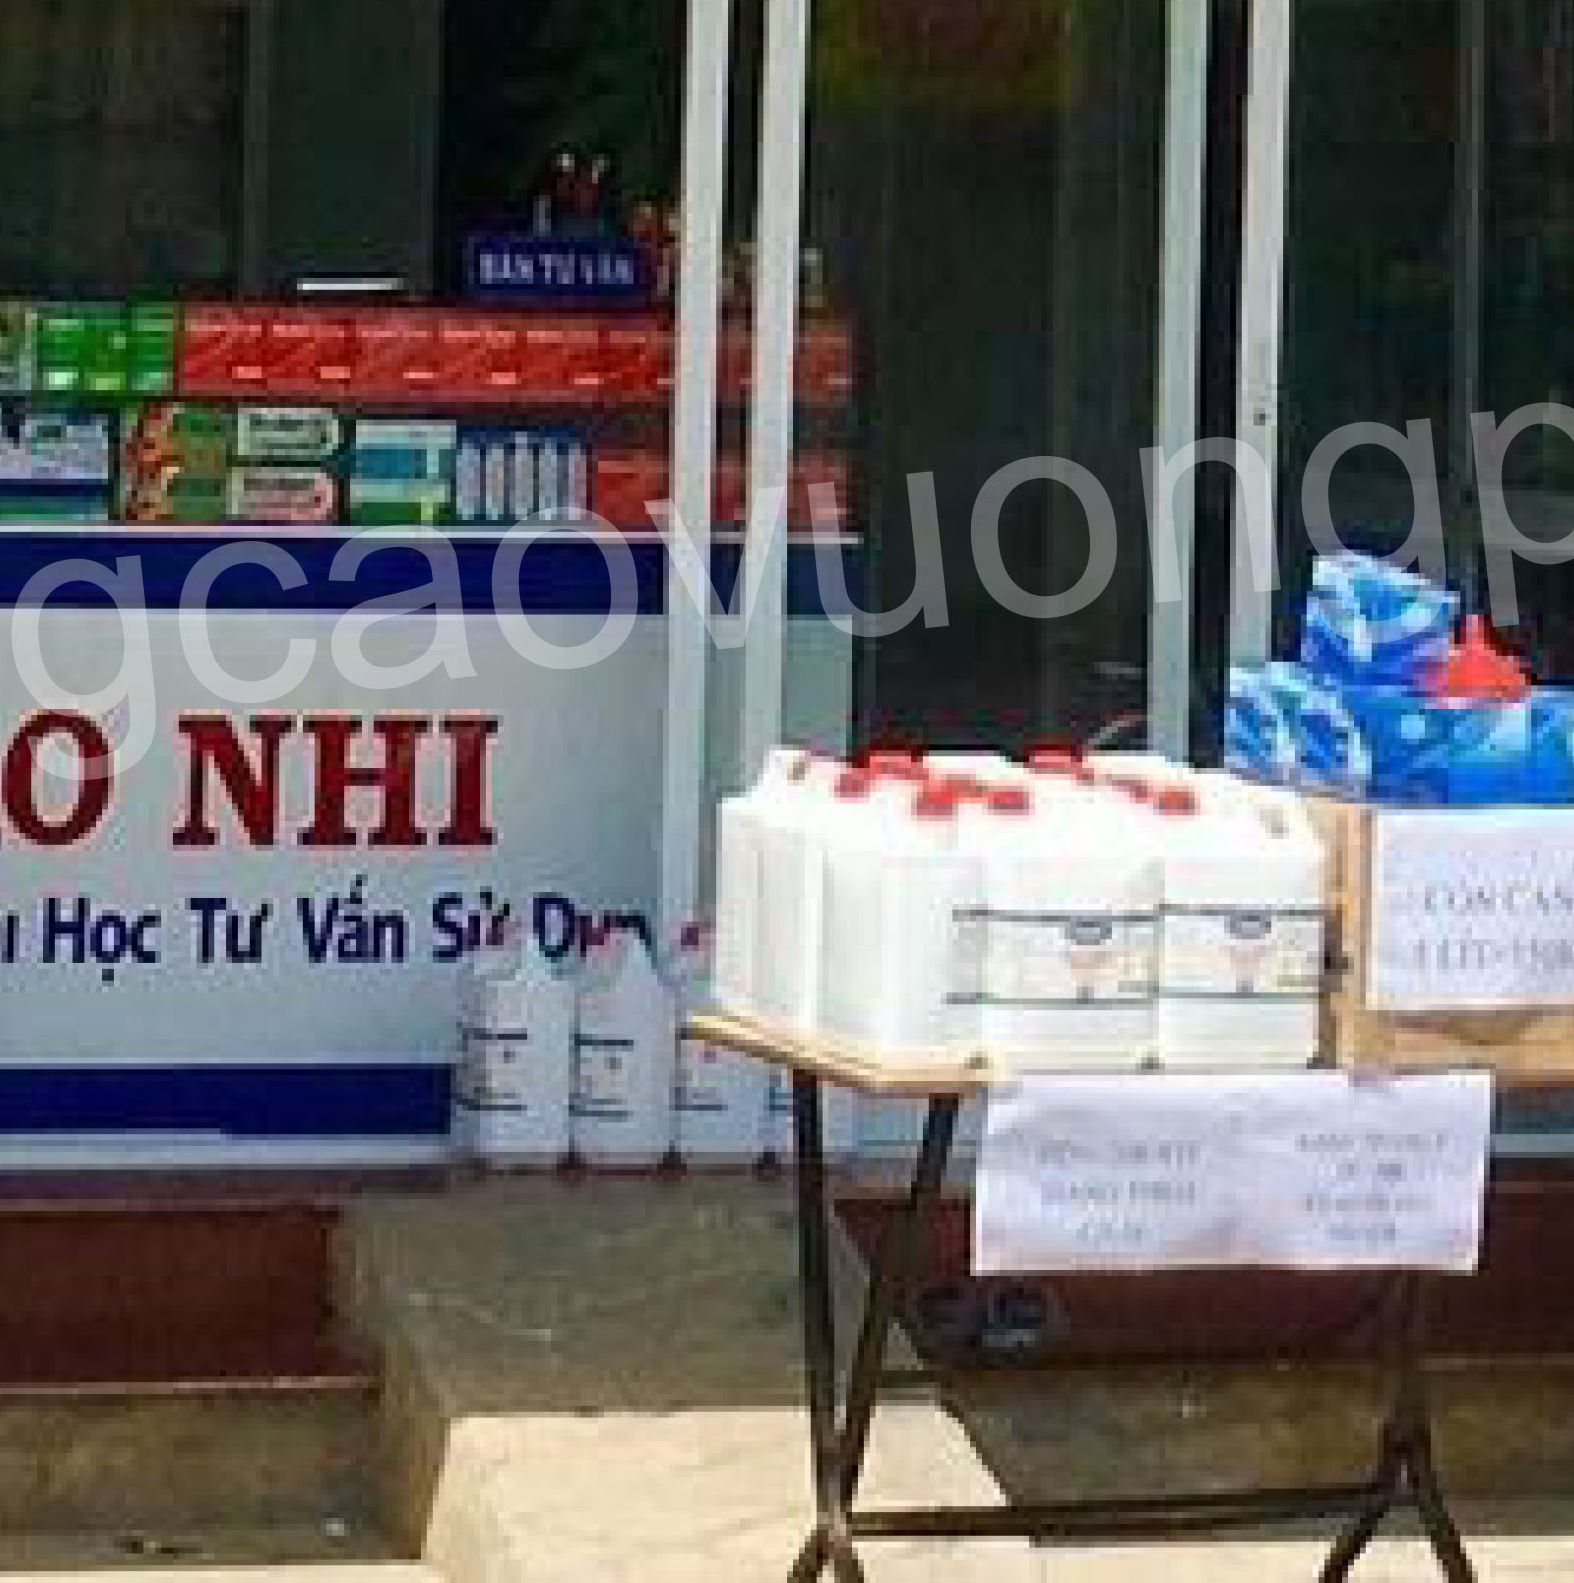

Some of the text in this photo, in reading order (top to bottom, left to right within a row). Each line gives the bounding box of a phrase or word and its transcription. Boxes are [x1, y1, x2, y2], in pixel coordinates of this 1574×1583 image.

[170, 711, 500, 850] NHI
[40, 895, 163, 982] Học
[186, 896, 275, 965] Tư
[295, 874, 407, 965] Vấn
